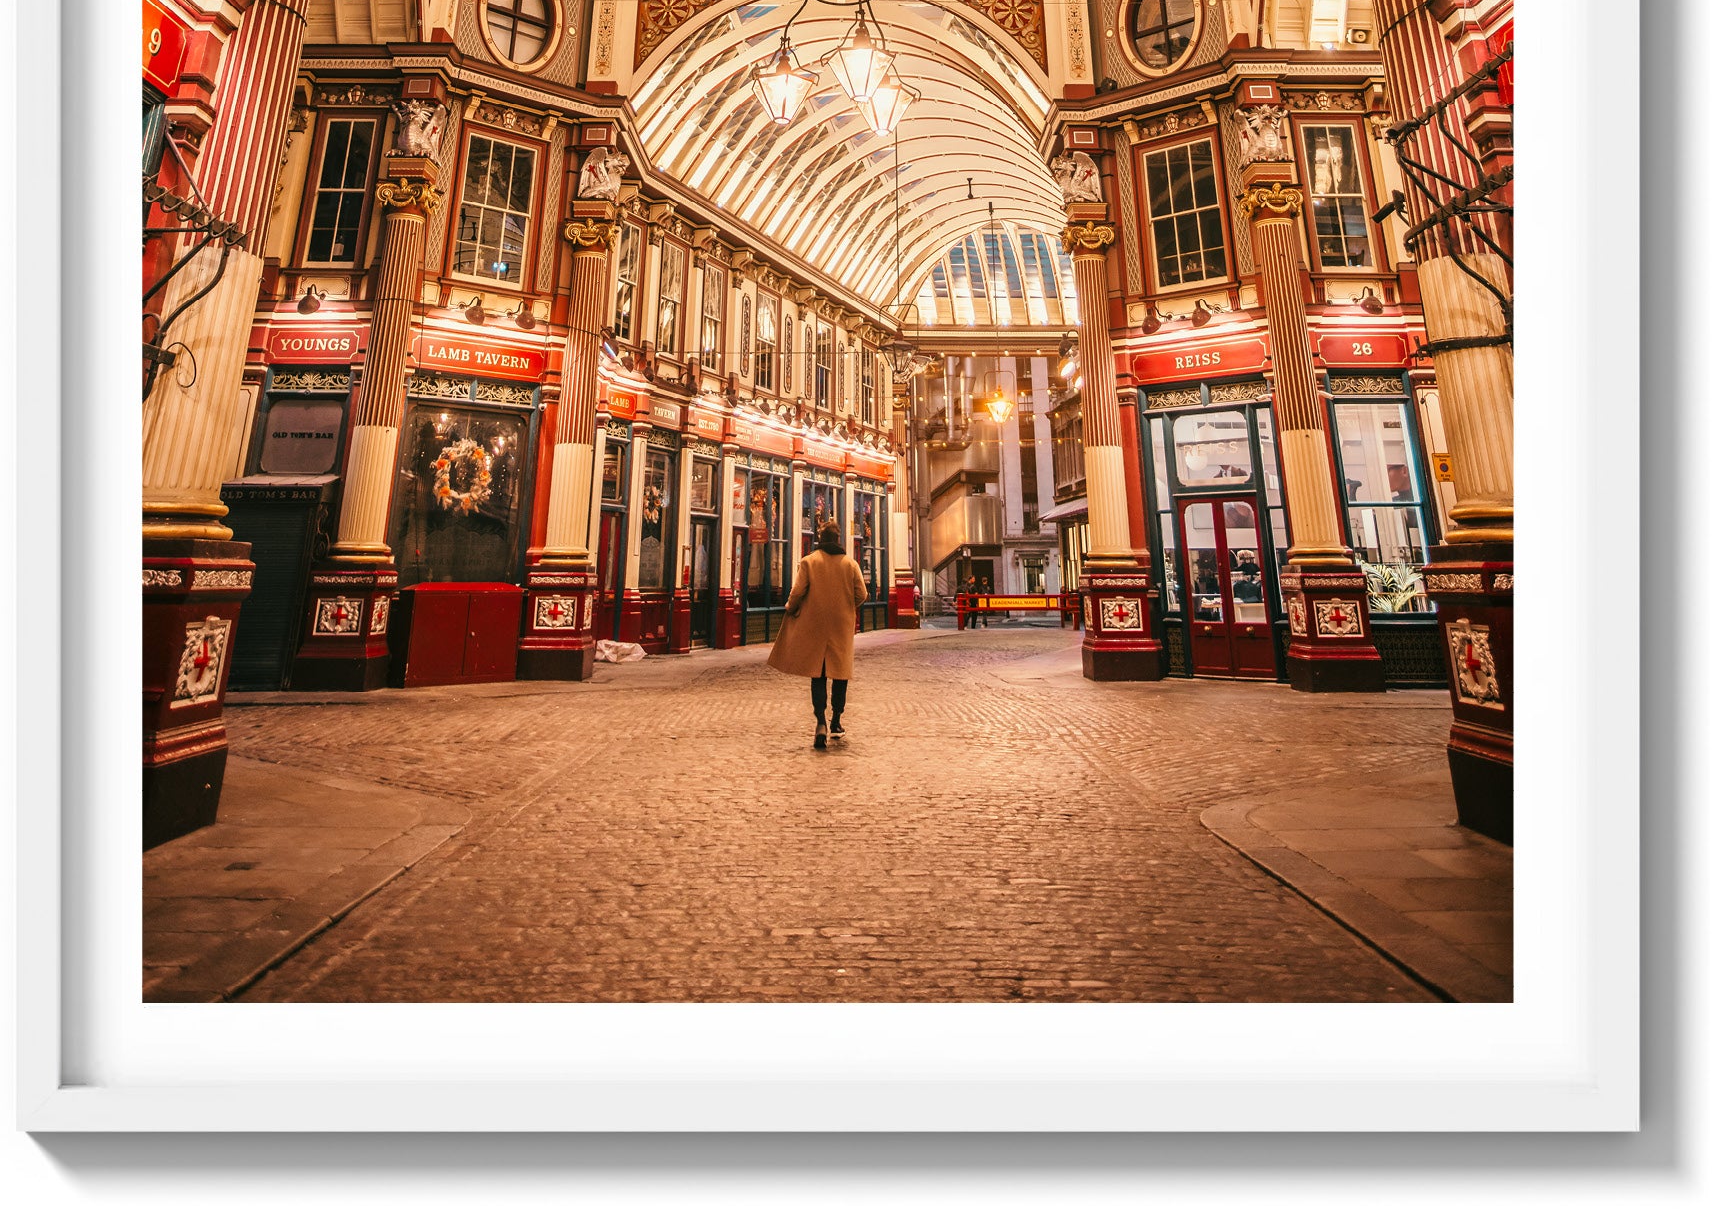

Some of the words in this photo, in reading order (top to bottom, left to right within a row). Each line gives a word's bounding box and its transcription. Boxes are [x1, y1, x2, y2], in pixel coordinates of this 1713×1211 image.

[148, 28, 162, 56] 9
[280, 338, 351, 351] YOUNGS
[1352, 342, 1373, 356] 26
[428, 345, 470, 362] LAMB
[475, 351, 530, 370] TAVERN
[1175, 352, 1221, 369] REISS
[610, 396, 630, 409] LAMB
[654, 406, 676, 421] TAVERN
[220, 491, 243, 499] OLD
[291, 491, 316, 499] BAR
